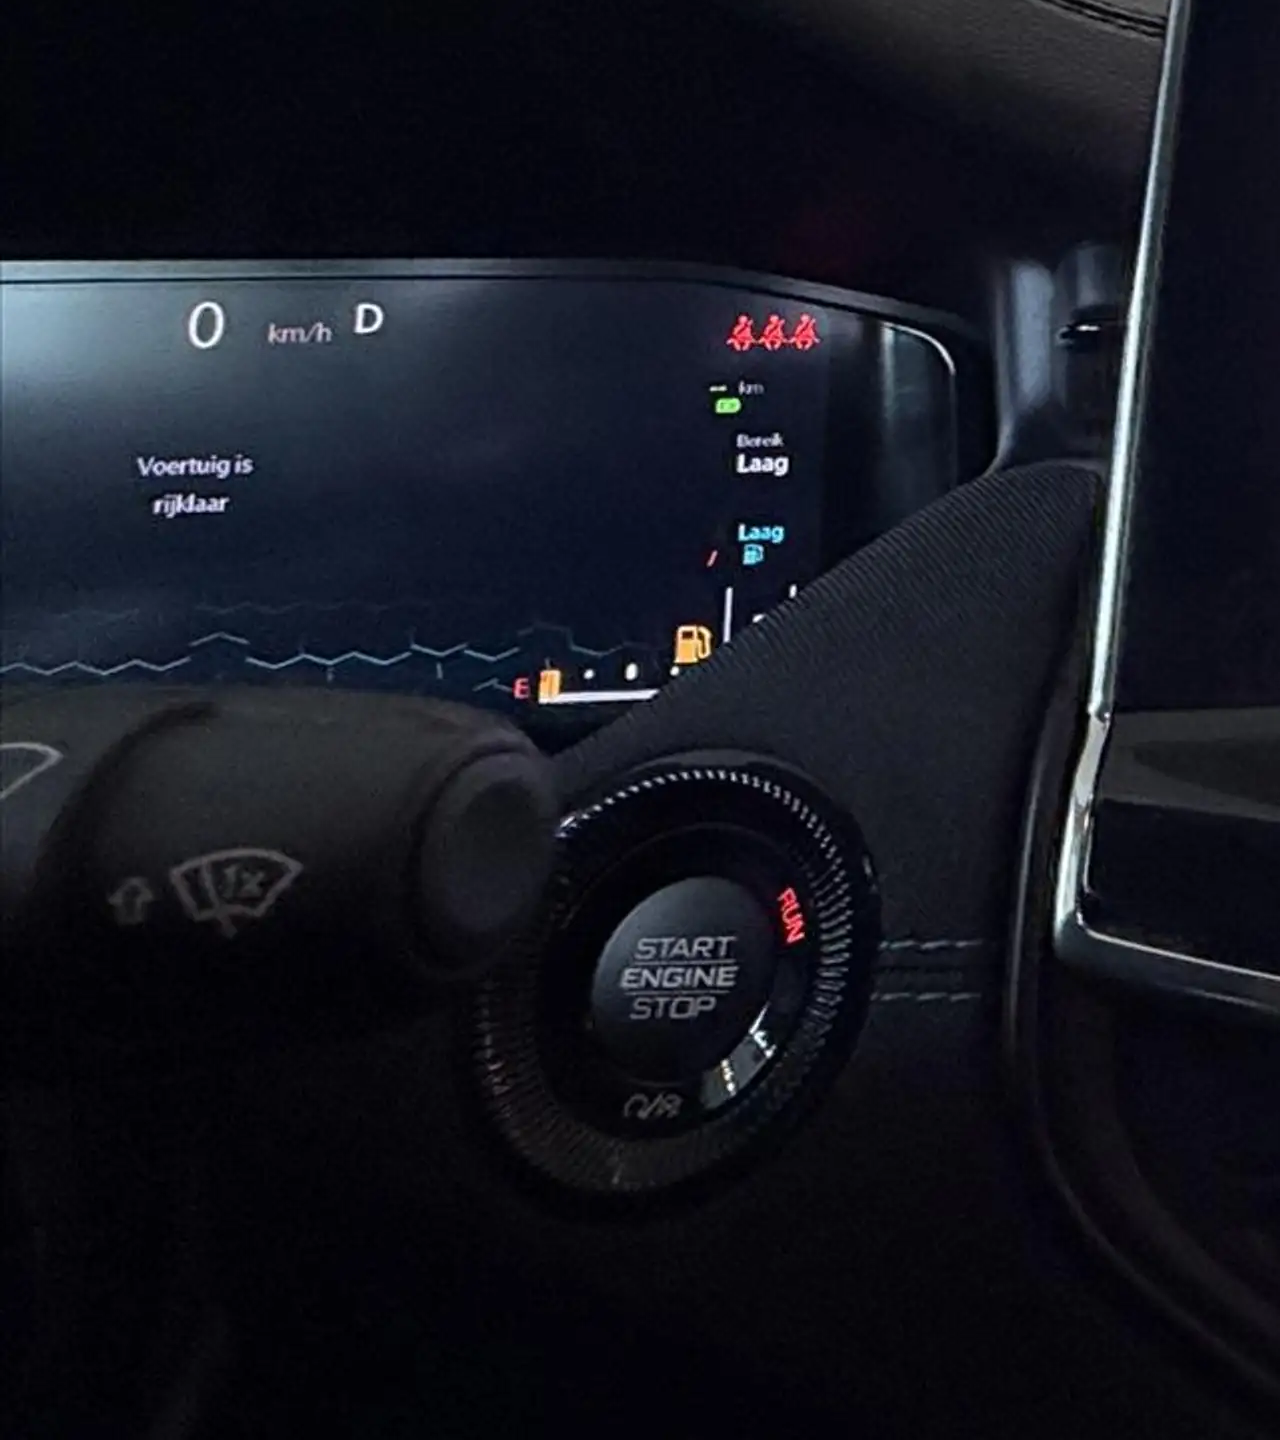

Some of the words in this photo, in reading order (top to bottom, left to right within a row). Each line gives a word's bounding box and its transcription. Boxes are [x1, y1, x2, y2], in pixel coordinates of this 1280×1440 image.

[187, 300, 226, 349] 0
[267, 322, 333, 345] km/h
[353, 303, 384, 334] D
[736, 432, 784, 449] Bereik
[137, 455, 230, 479] Voertuig
[234, 454, 255, 474] is
[736, 453, 790, 477] Laag
[152, 493, 229, 519] rijklaar
[738, 523, 785, 544] Laag
[776, 885, 806, 945] RUN
[633, 935, 739, 961] START
[618, 965, 740, 990] ENGINE
[628, 996, 718, 1021] STOP
